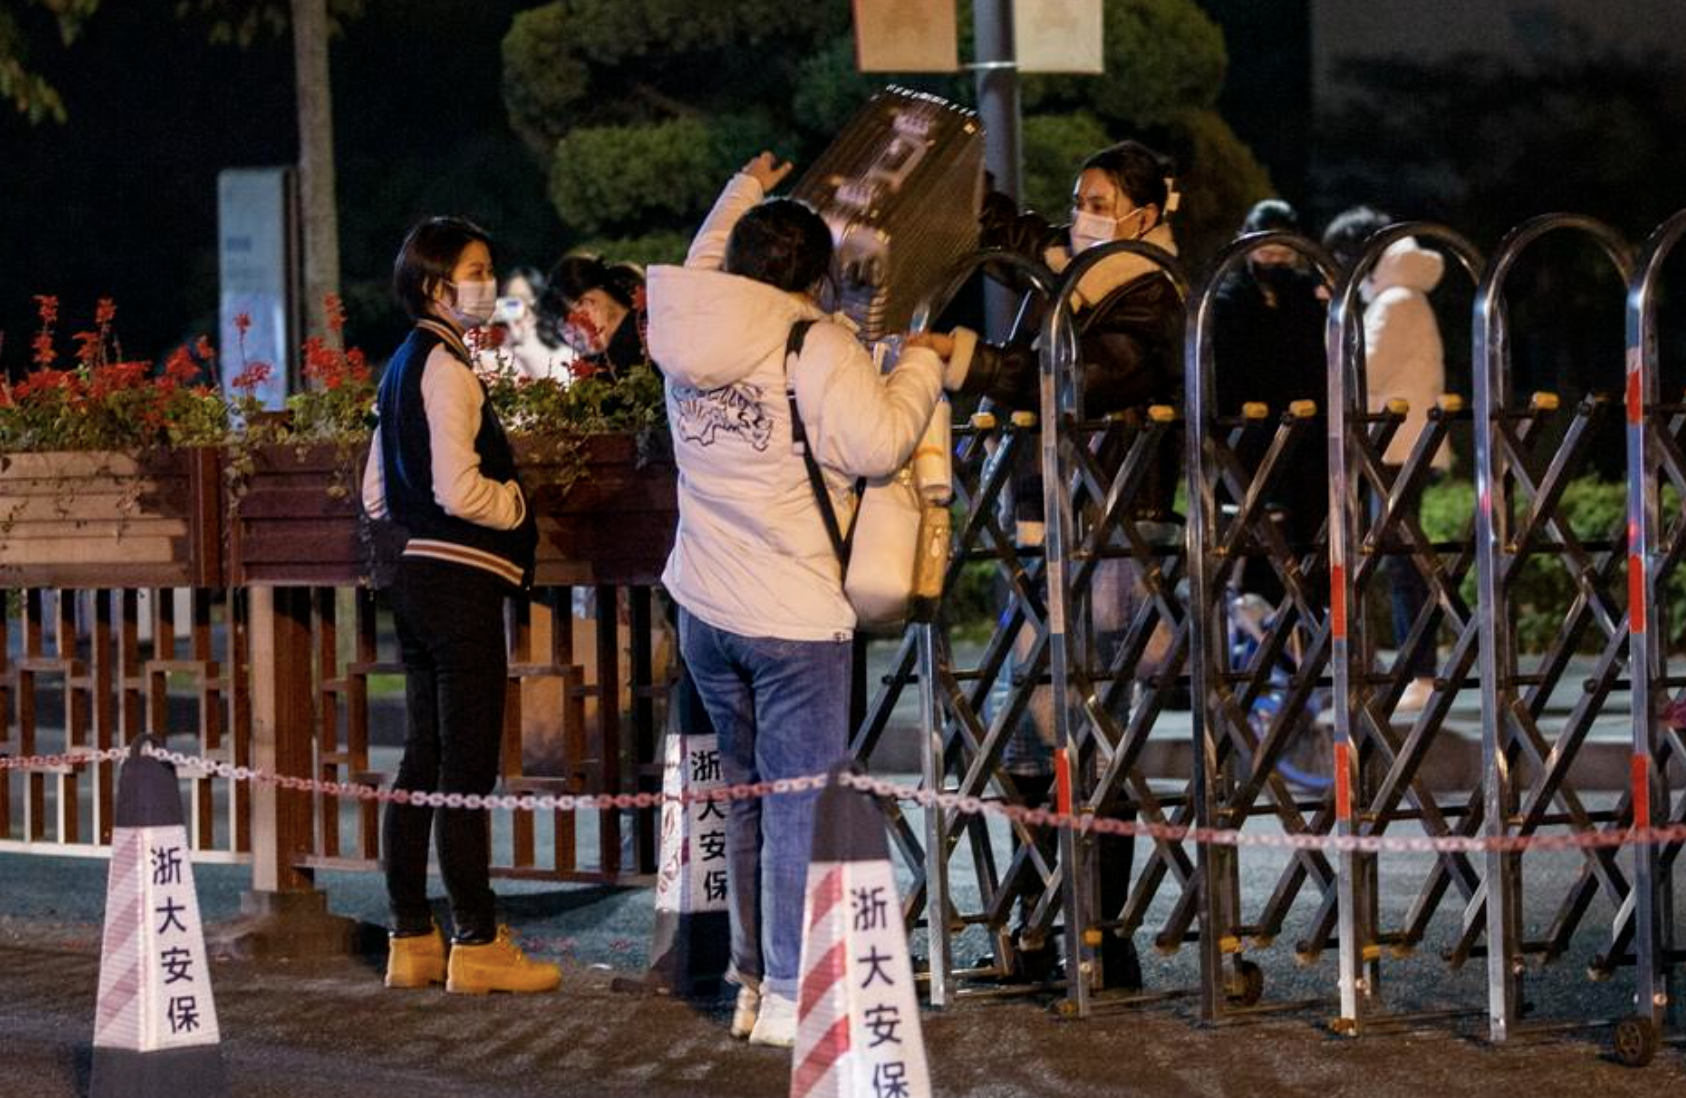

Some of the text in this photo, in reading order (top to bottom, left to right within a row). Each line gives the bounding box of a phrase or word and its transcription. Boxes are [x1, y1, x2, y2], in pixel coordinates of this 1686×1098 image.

[151, 847, 200, 1034] 浙大安保
[851, 887, 909, 1098] 浙大安保
